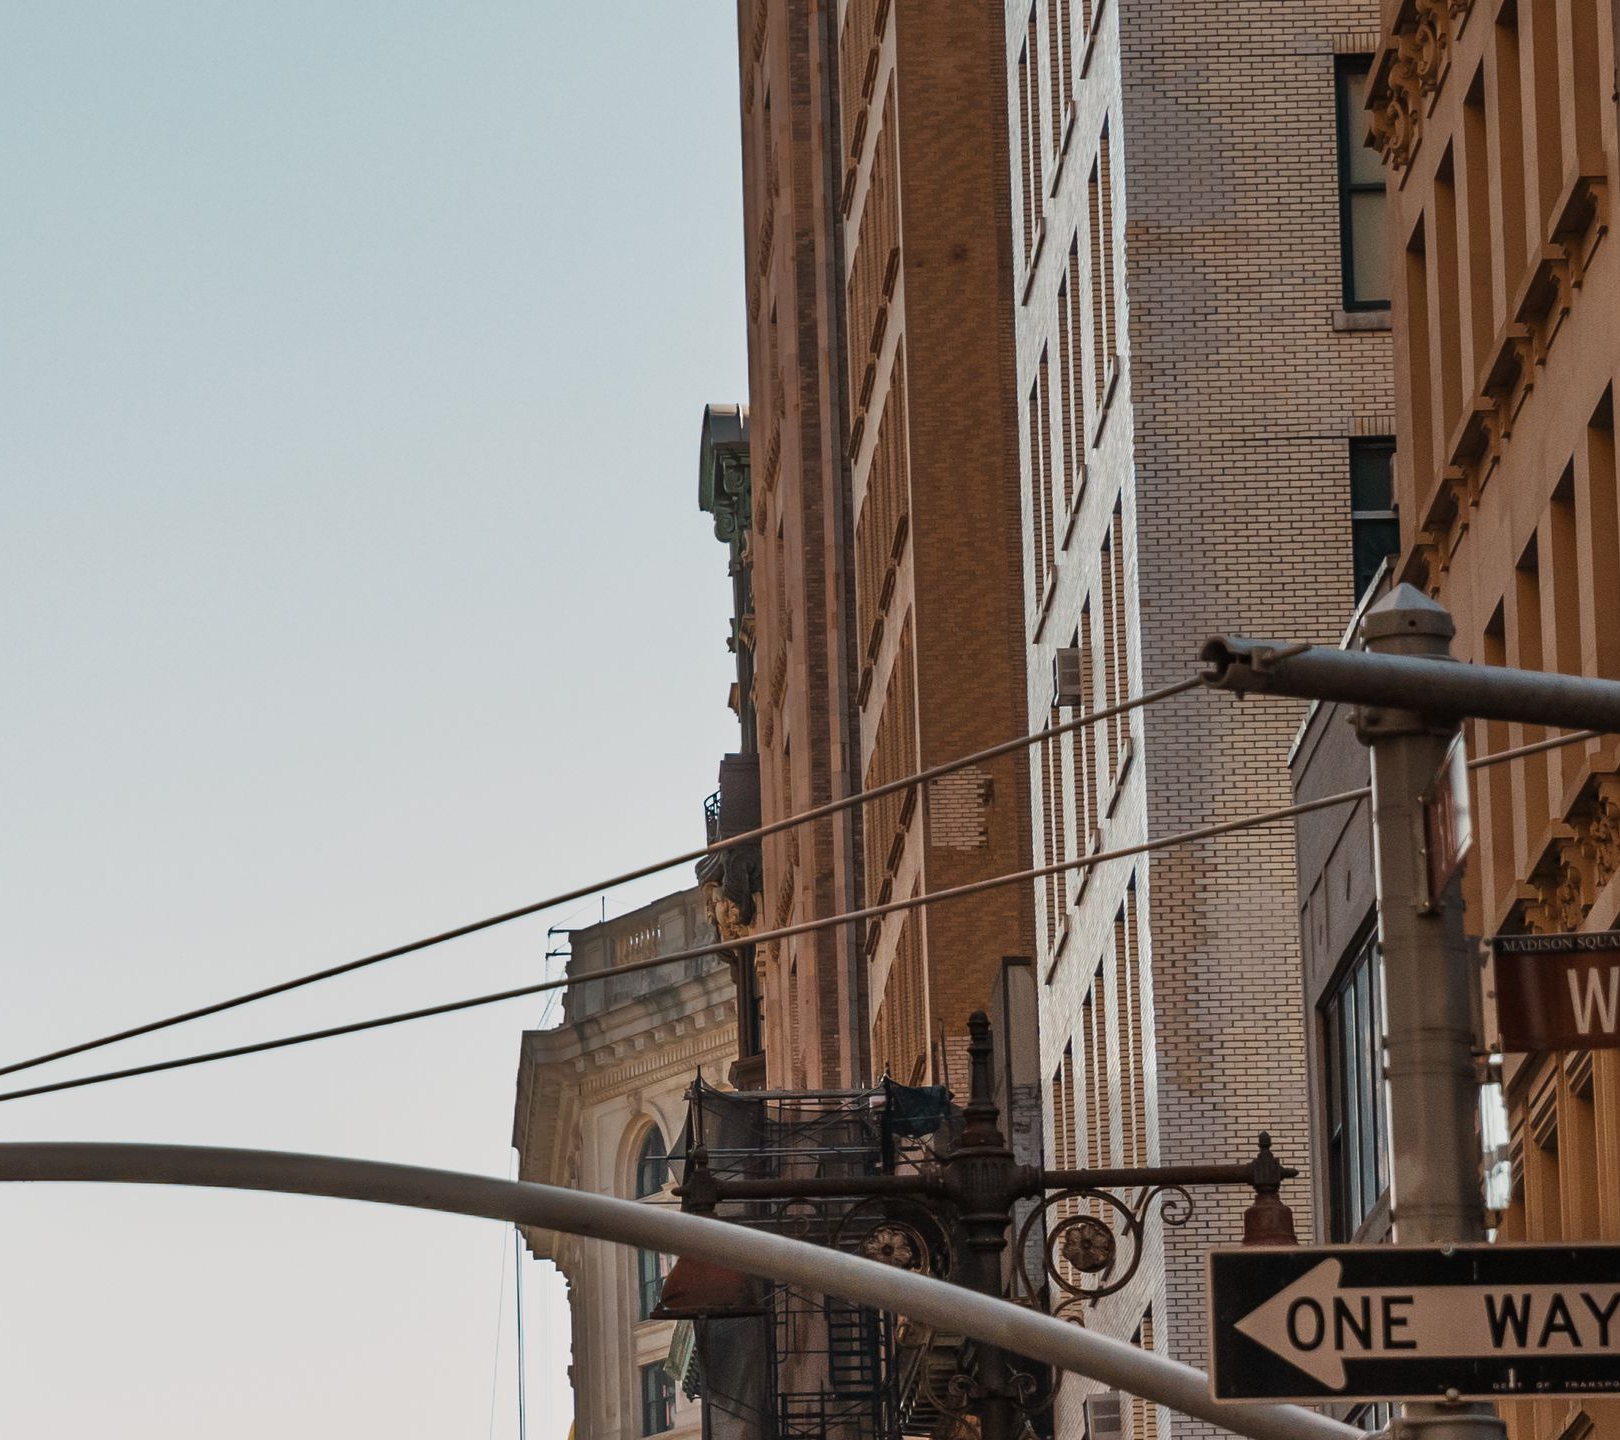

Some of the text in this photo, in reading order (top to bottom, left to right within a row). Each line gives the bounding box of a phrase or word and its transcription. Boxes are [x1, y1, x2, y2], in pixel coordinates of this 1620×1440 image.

[1502, 936, 1572, 952] MADISON
[1566, 966, 1620, 1035] W
[1285, 1295, 1417, 1351] ONE
[1536, 1381, 1551, 1389] OF
